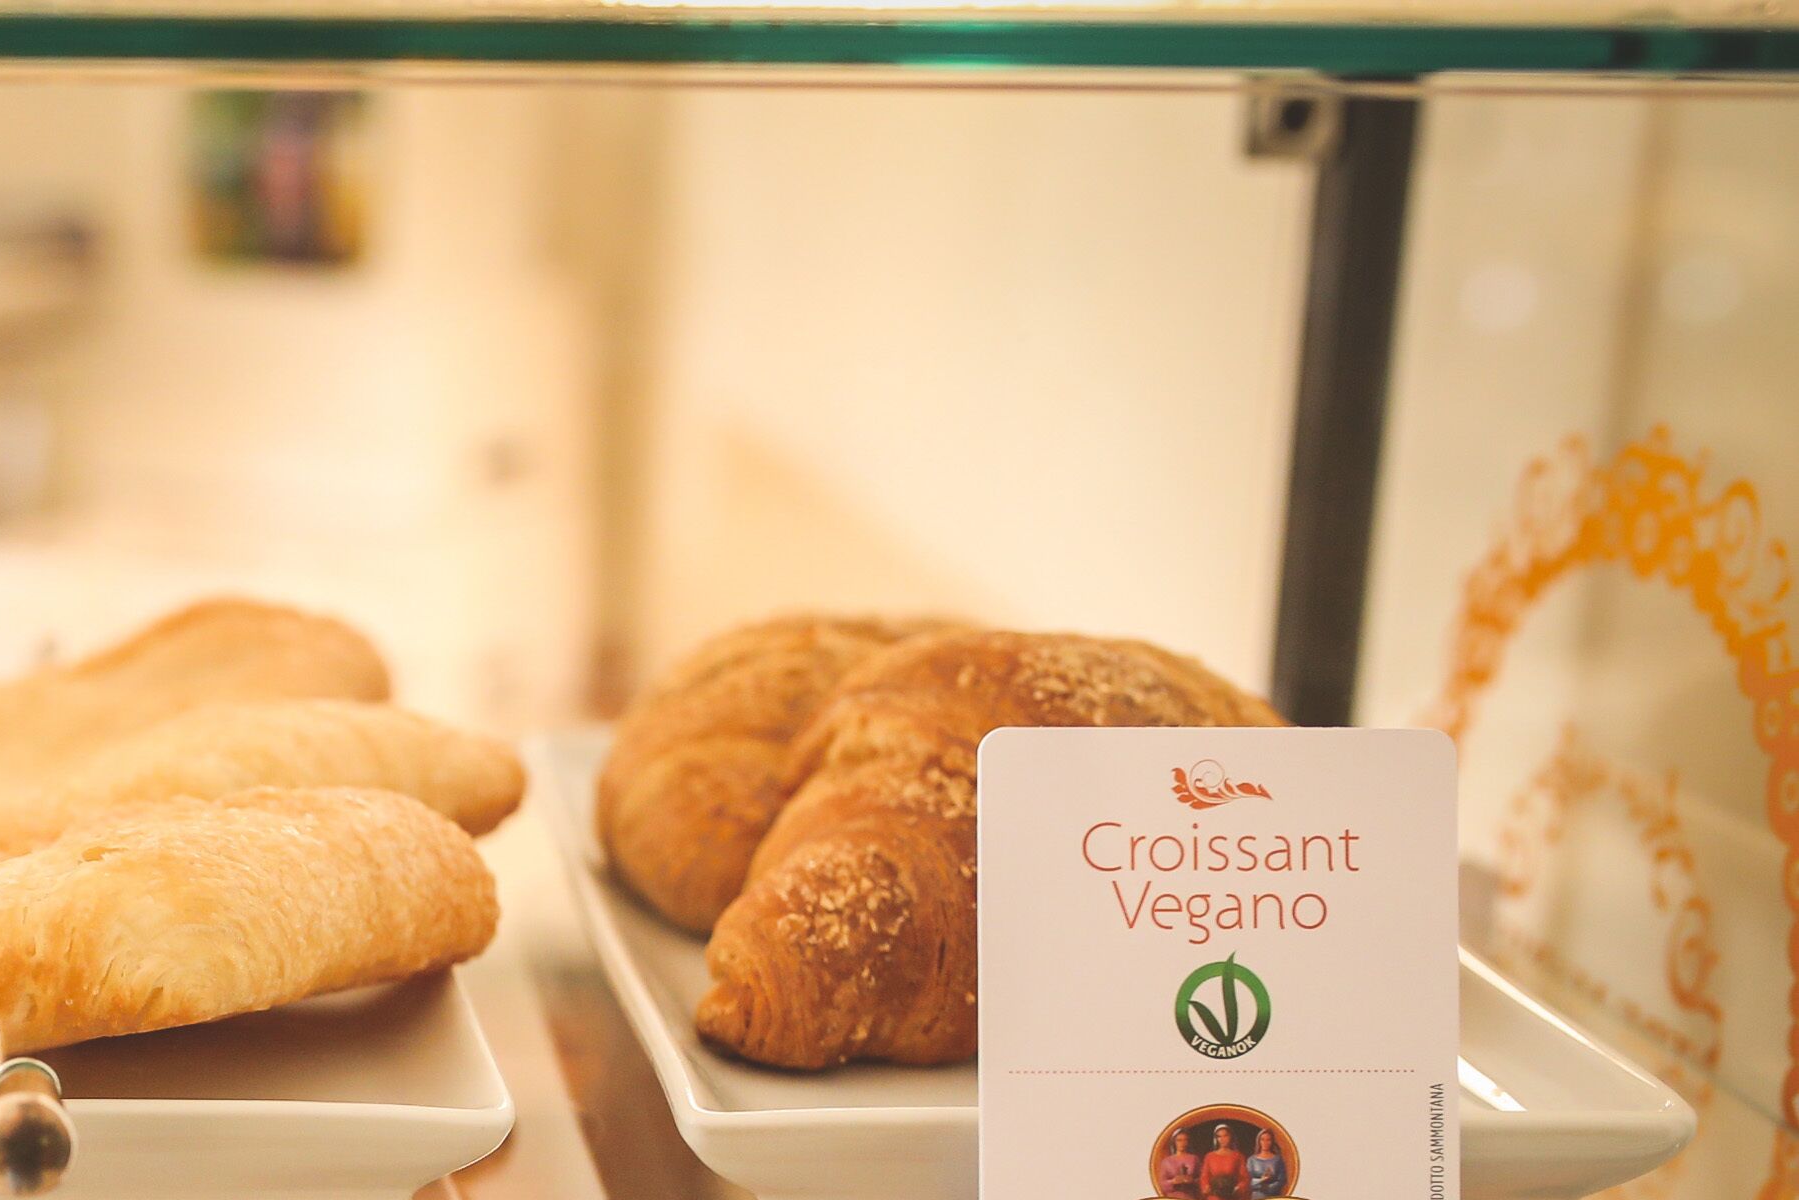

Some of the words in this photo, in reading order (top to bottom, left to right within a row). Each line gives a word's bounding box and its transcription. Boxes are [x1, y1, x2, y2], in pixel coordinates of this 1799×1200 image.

[1081, 821, 1361, 873] Croissant
[1111, 879, 1329, 945] Vegano
[1189, 1032, 1258, 1060] VEGANOK
[1429, 1083, 1445, 1162] SAMMONTANA
